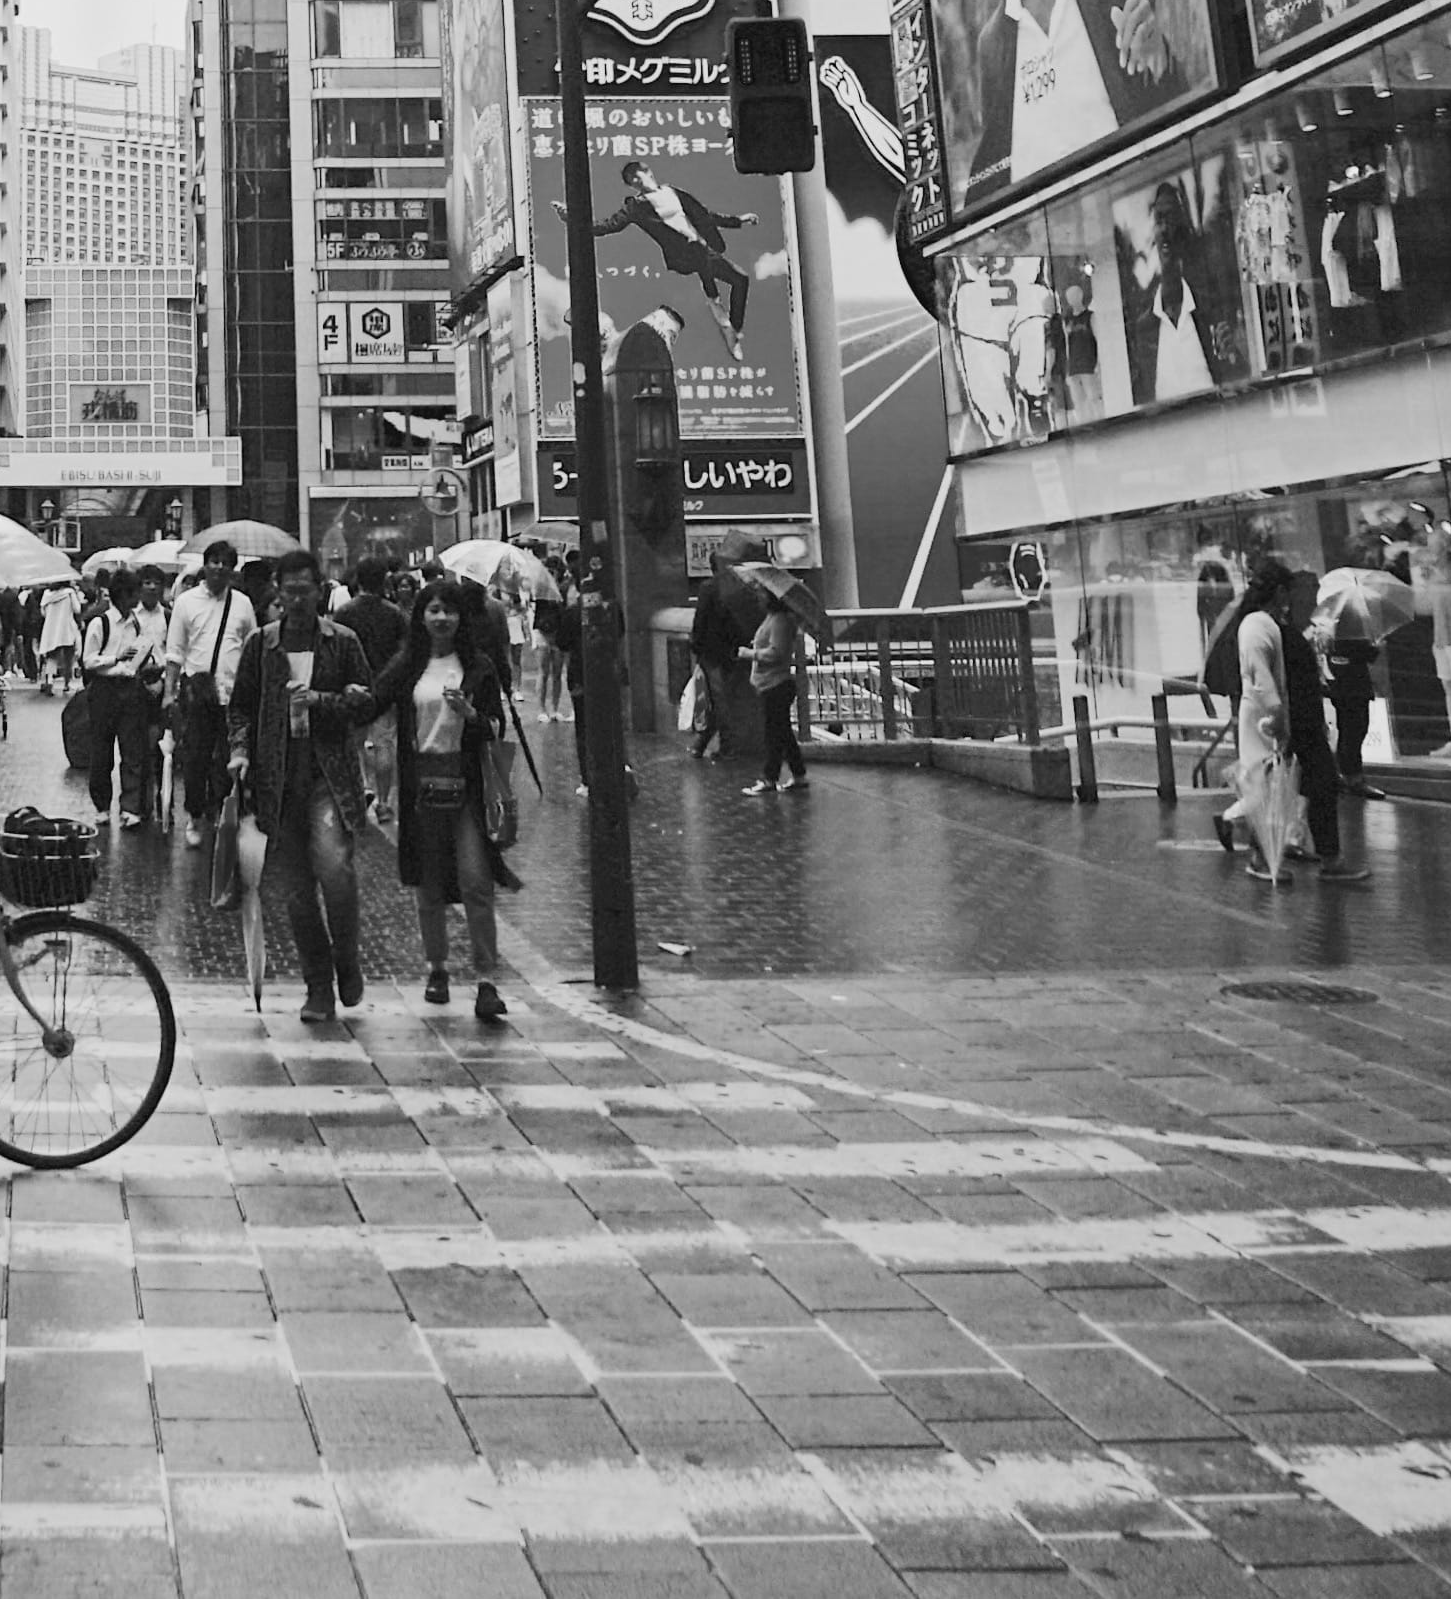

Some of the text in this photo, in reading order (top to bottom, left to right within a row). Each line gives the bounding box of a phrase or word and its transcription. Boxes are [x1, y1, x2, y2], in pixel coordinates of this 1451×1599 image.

[554, 56, 731, 85] 印メグミル
[911, 8, 941, 205] インターネット
[901, 102, 925, 213] コミック
[327, 242, 344, 259] 5F
